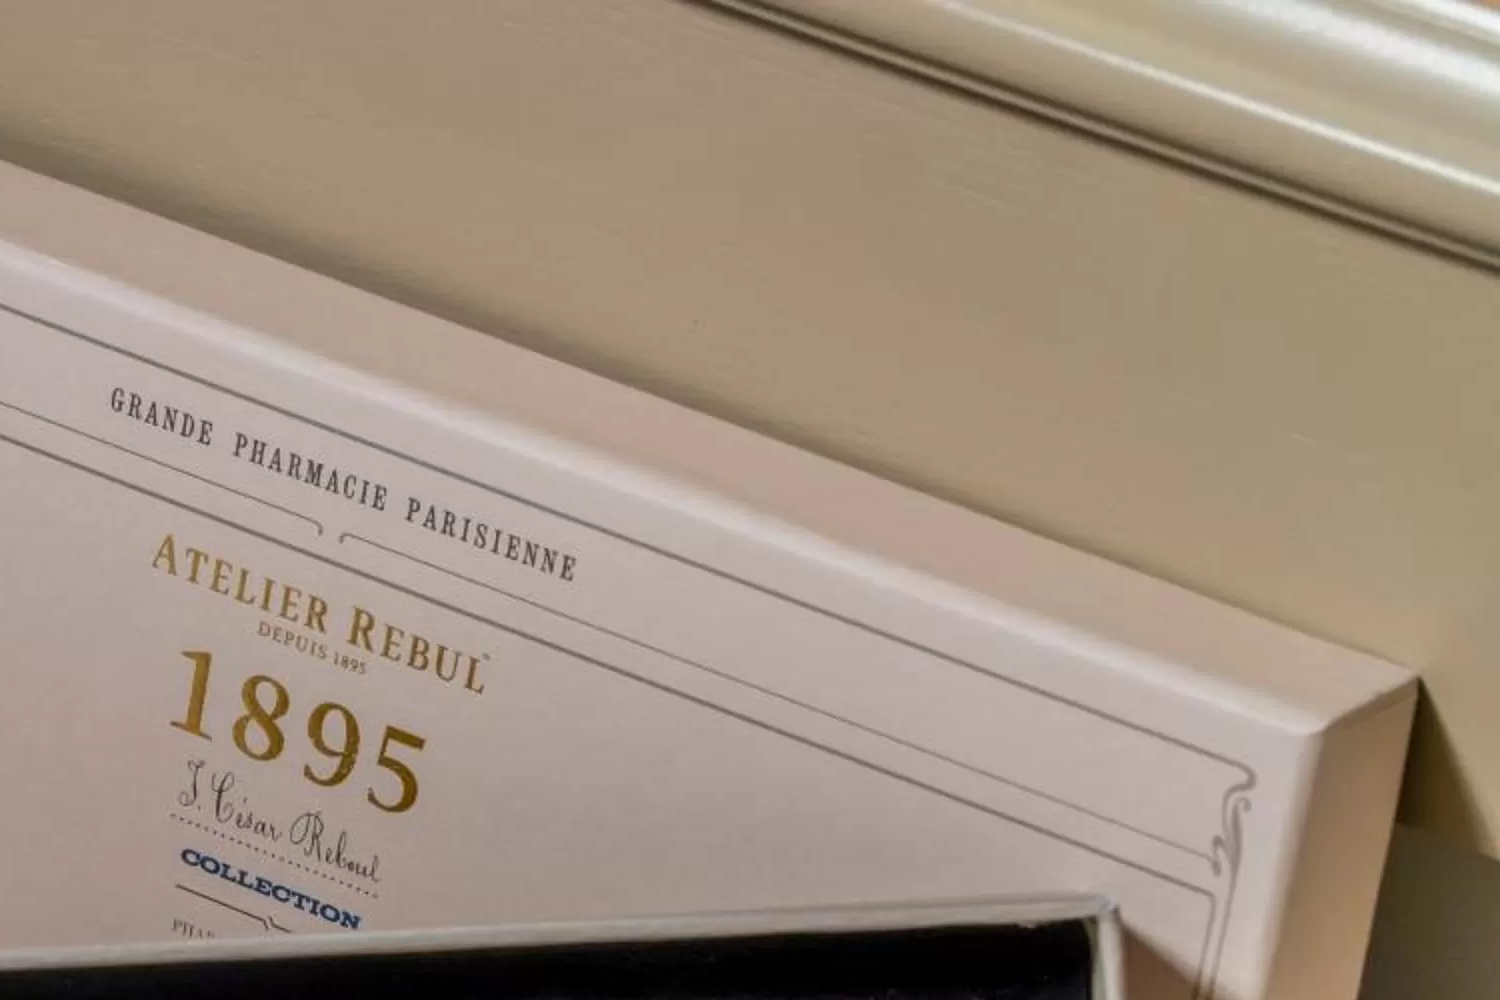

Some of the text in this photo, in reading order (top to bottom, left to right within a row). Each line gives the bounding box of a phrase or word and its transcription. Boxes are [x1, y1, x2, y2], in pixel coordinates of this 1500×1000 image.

[111, 387, 577, 582] GRANDE PHARMACIE PARISIENNE
[152, 533, 487, 695] ATELIER REBUL
[258, 621, 367, 676] DEPUIS 1895
[170, 650, 426, 813] 1895
[181, 847, 362, 930] COLLECTION
